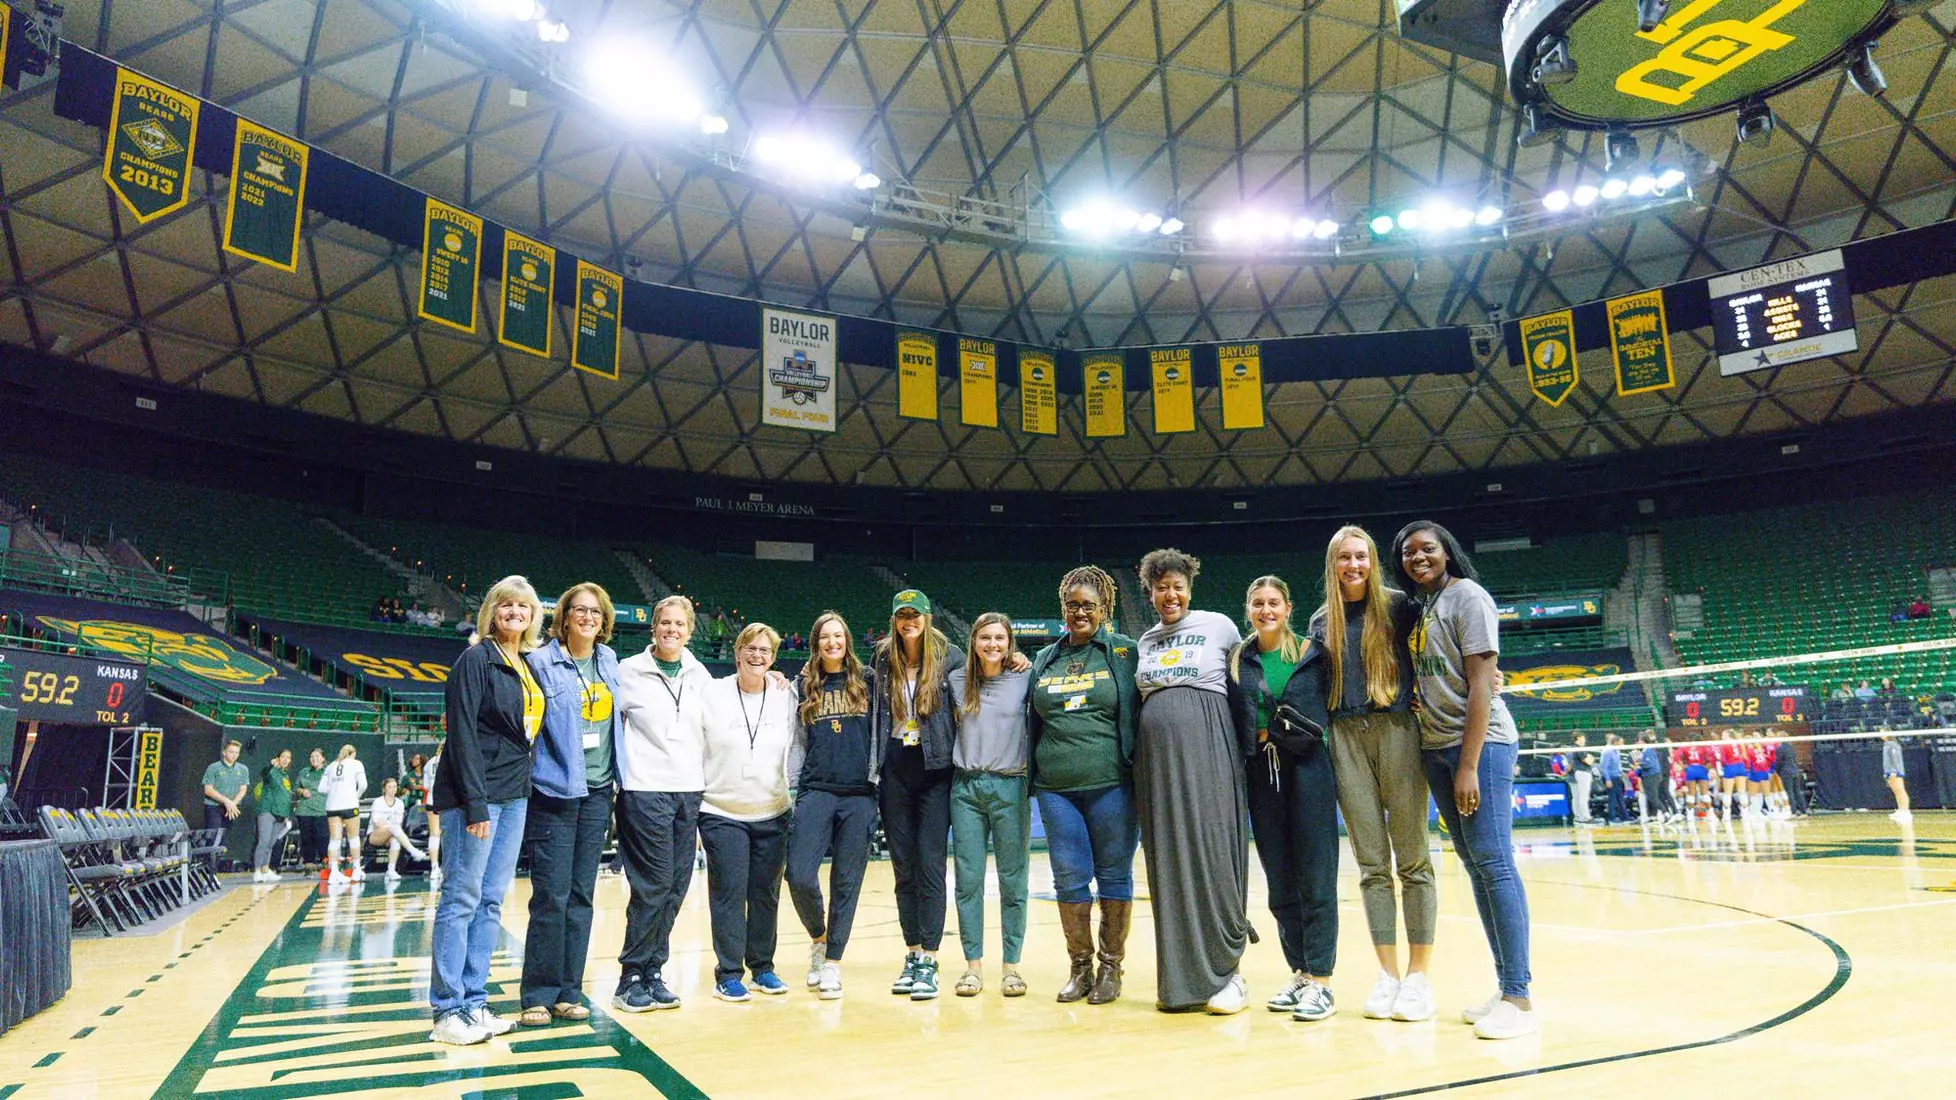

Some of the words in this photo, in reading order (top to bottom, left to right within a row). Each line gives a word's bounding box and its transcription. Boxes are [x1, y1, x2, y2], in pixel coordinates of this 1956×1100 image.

[122, 81, 193, 121] BAYLOR
[138, 102, 175, 122] BEARS
[241, 131, 303, 167] BAYLOR
[120, 151, 179, 179] CHAMPIONS
[119, 164, 174, 196] 2013
[243, 171, 294, 196] CHAMPIONS
[242, 183, 265, 198] 2021
[241, 191, 264, 207] 2022
[430, 207, 478, 236] BAYLOR
[508, 239, 552, 265] BAYLOR
[1741, 259, 1806, 283] CEN-TEX
[580, 268, 620, 293] BAYLOR
[428, 288, 448, 301] 2021
[1768, 295, 1793, 308] KILLS
[508, 299, 525, 312] 2021
[1612, 298, 1660, 316] BAYLOR
[580, 326, 596, 337] 2021
[770, 316, 829, 342] BAYLOR
[1767, 320, 1802, 334] BLOCKS
[779, 338, 821, 349] VOLLEYBALL
[1773, 330, 1798, 341] ACES
[960, 339, 995, 355] BAYLOR
[1219, 344, 1259, 358] BAYLOR
[1627, 345, 1656, 361] TEN
[902, 353, 933, 367] NIVC
[1151, 349, 1190, 362] BAYLOR
[774, 374, 826, 388] CHAMPIONSHIP
[770, 407, 800, 420] FINAL
[802, 410, 829, 423] FOUR
[696, 497, 724, 509] PAUL
[736, 501, 774, 513] MEYER
[777, 504, 815, 515] ARENA
[97, 665, 138, 680] KANSAS
[1141, 666, 1199, 681] CHAMPIONS
[20, 670, 80, 705] 59.2
[106, 682, 124, 708] 0
[1769, 688, 1803, 697] KANSAS
[1675, 693, 1707, 702] BAYLOR
[1781, 697, 1795, 714] 0
[96, 710, 117, 723] TOL
[122, 712, 129, 723] 2
[1687, 702, 1699, 718] 0
[138, 736, 159, 809] BEAR
[336, 764, 344, 776] 8
